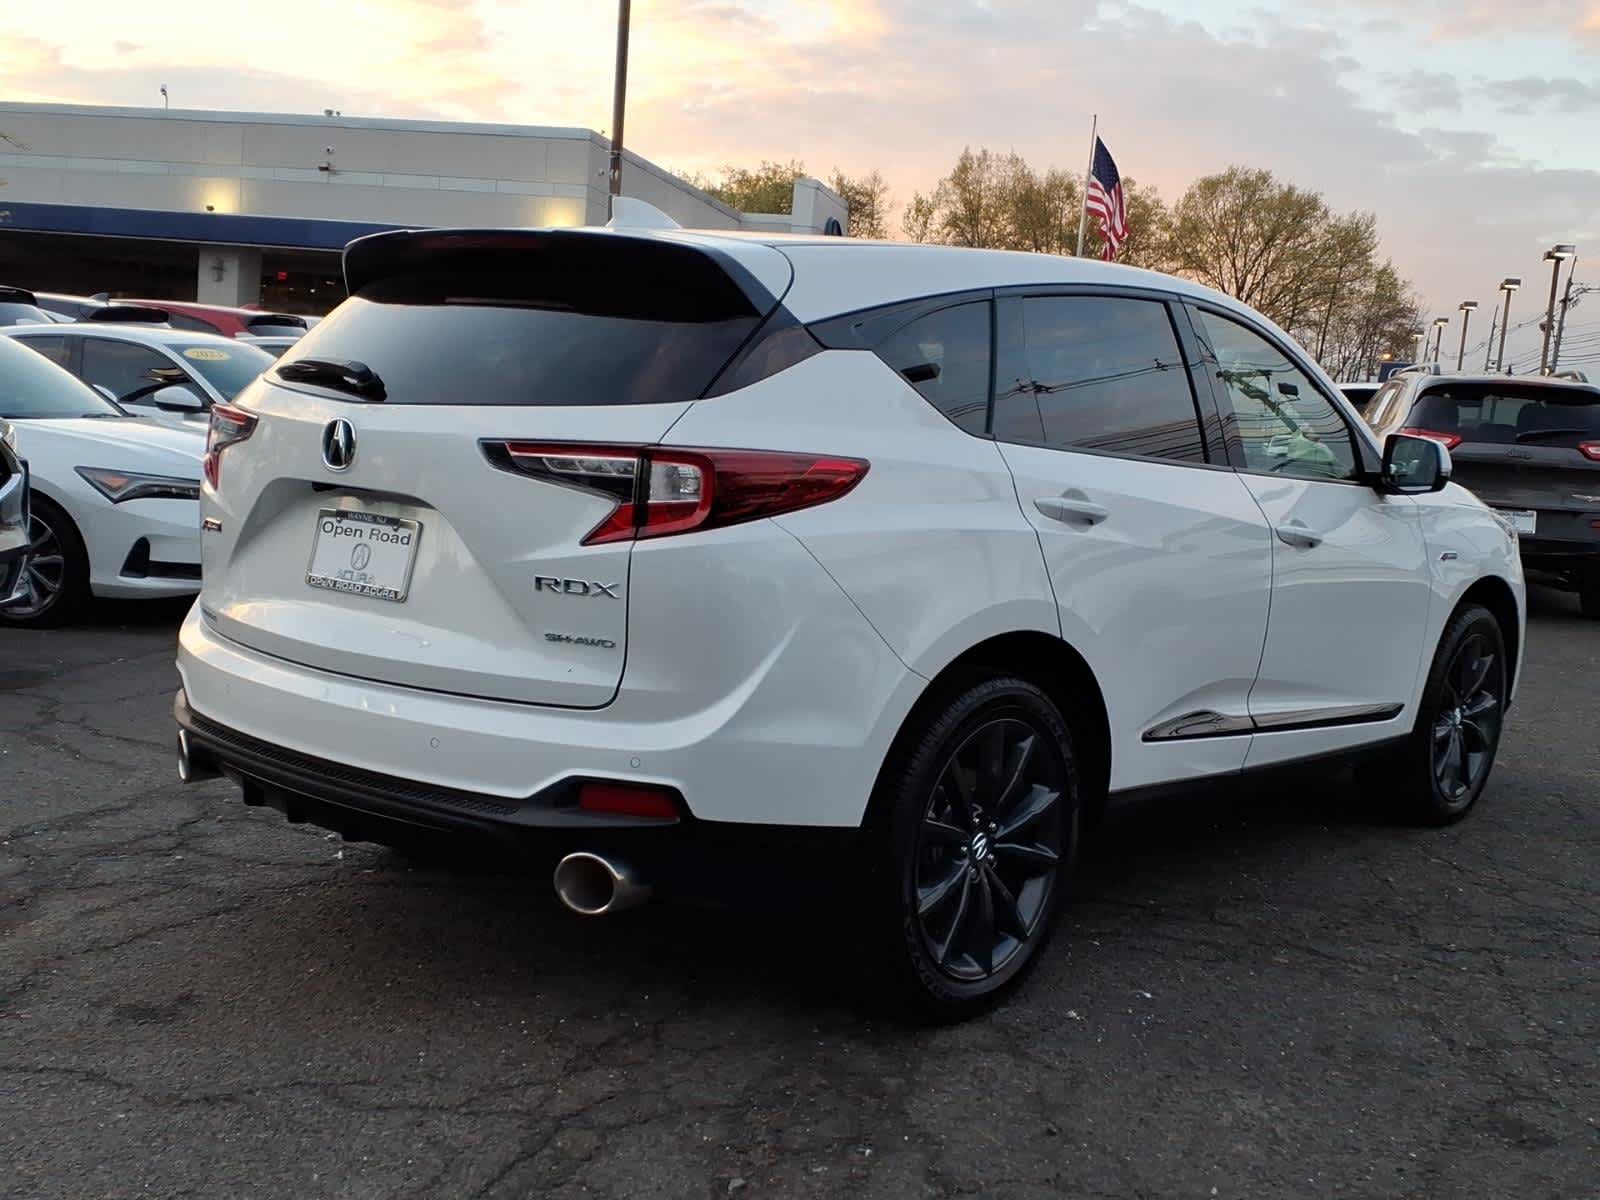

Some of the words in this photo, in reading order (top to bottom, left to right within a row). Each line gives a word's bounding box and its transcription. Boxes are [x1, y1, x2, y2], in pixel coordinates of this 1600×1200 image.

[322, 520, 363, 538] Open
[368, 528, 412, 546] Road
[310, 576, 334, 588] OPEN
[335, 581, 362, 593] ROAD
[363, 586, 396, 598] ACURA
[534, 574, 620, 600] RDX
